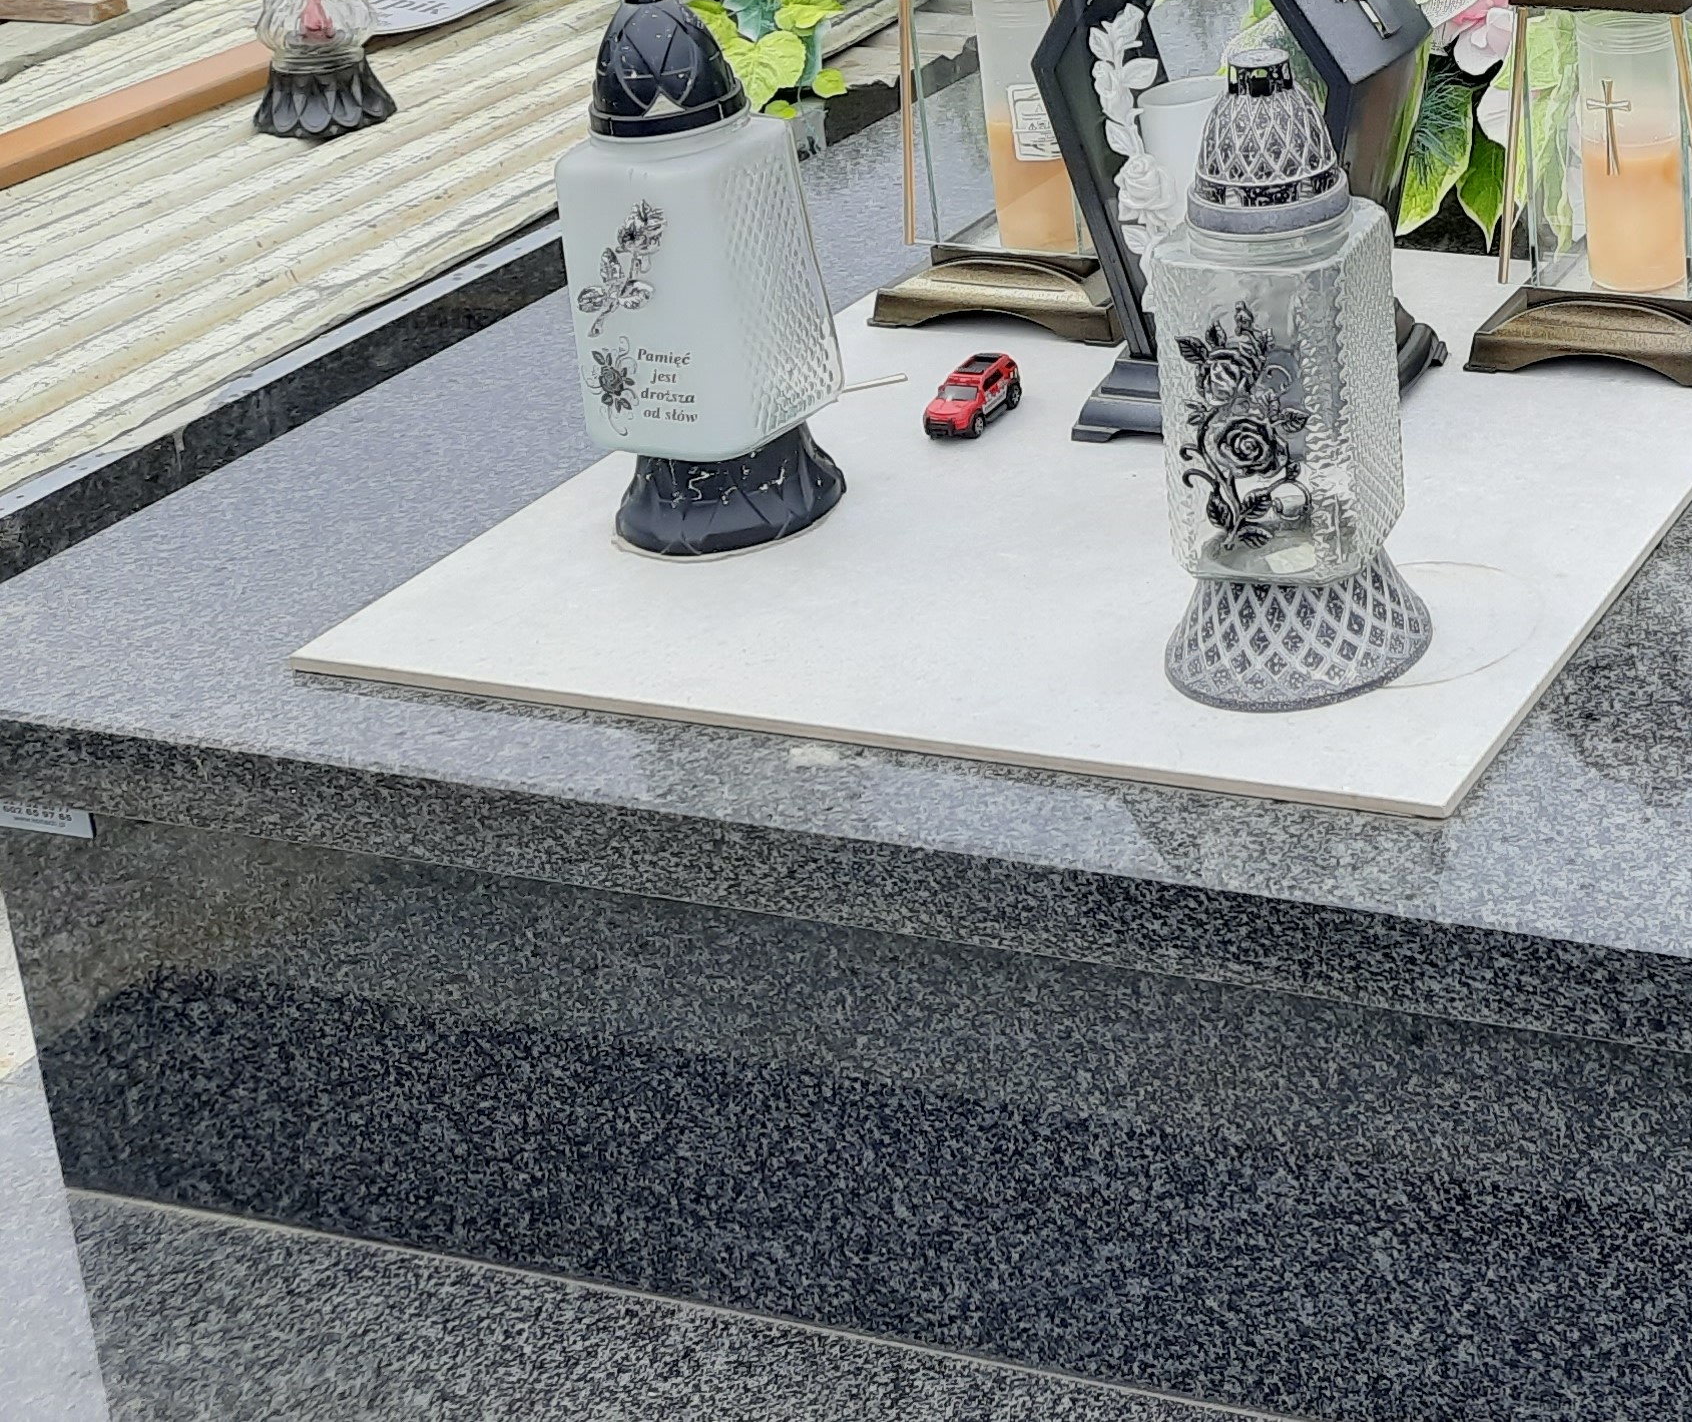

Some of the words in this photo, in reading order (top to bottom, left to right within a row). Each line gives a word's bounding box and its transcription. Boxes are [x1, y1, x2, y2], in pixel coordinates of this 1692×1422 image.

[637, 347, 691, 367] Pamięć
[650, 366, 677, 385] jest
[640, 387, 696, 405] droższa
[643, 406, 662, 420] od
[664, 407, 698, 424] słów
